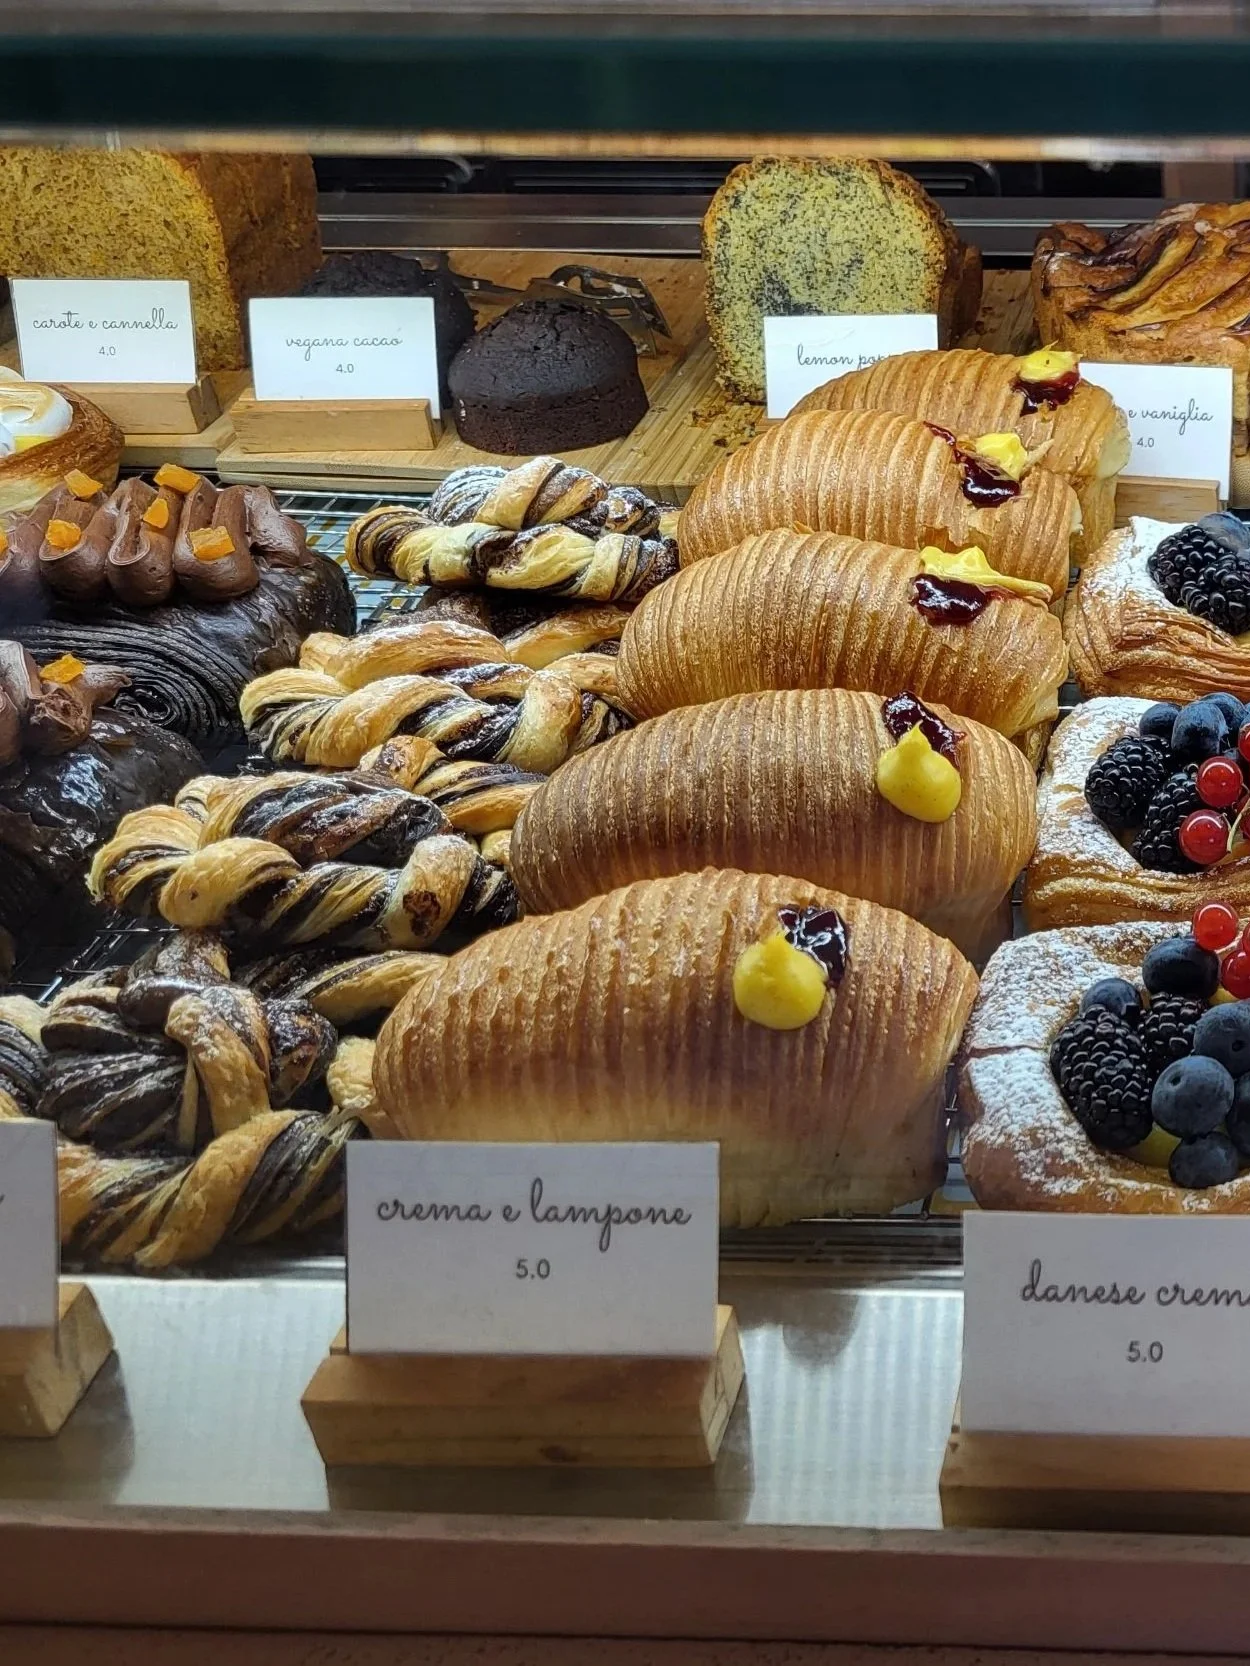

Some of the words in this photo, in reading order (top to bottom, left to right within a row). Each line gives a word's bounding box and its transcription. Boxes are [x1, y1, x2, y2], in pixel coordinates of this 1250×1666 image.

[32, 310, 84, 330] carote
[88, 319, 98, 330] e
[102, 307, 179, 330] cannella
[98, 345, 117, 357] 4.0
[286, 336, 349, 362] vegana
[797, 343, 854, 366] lemon
[335, 363, 355, 374] 4.0
[1128, 409, 1138, 419] e
[1141, 398, 1214, 436] vaniglia
[1136, 437, 1155, 448] 4.0
[376, 1198, 492, 1222] crema
[502, 1202, 521, 1221] e
[530, 1176, 693, 1253] lampone
[515, 1258, 551, 1280] 5.0
[1020, 1257, 1147, 1306] danese
[1126, 1340, 1164, 1364] 5.0
